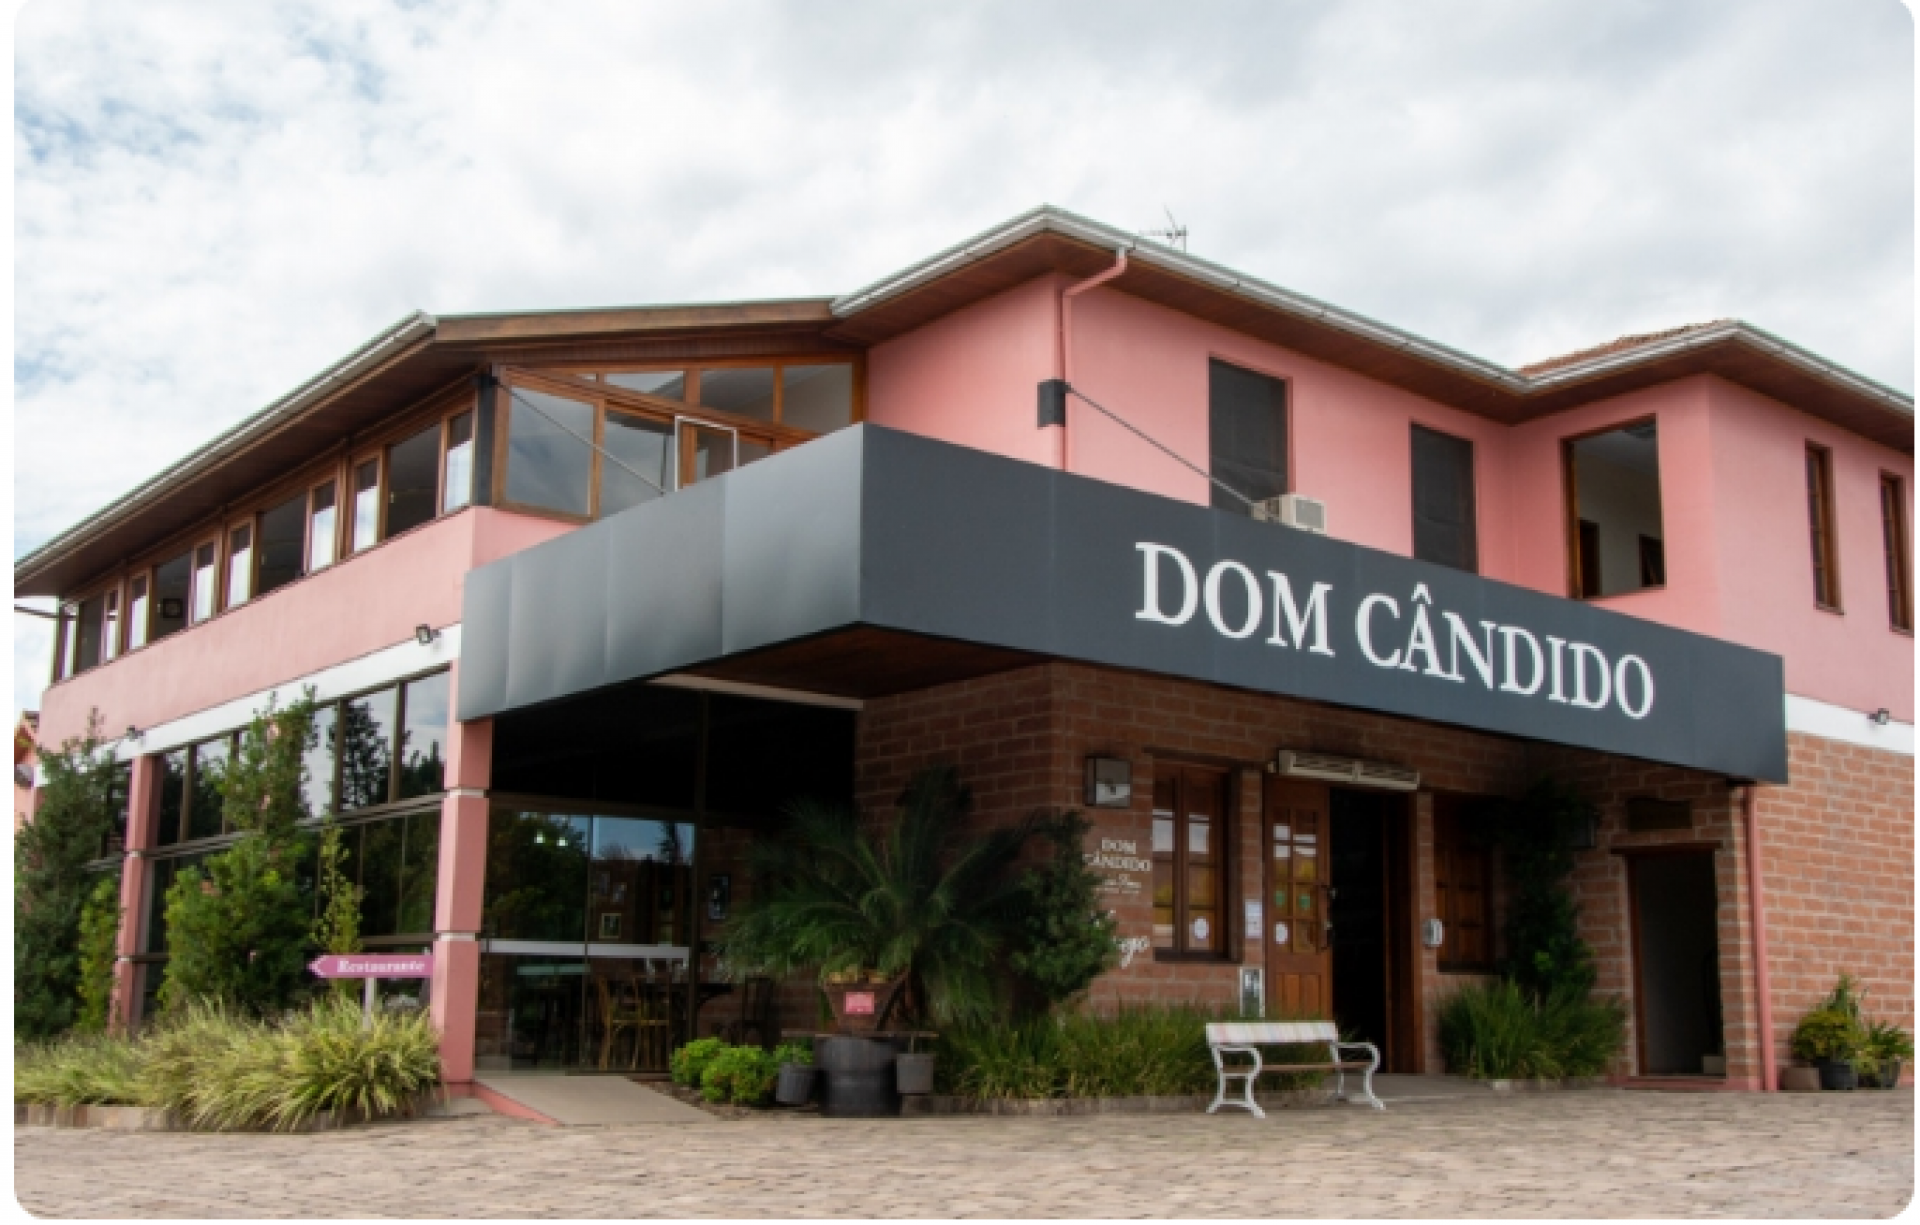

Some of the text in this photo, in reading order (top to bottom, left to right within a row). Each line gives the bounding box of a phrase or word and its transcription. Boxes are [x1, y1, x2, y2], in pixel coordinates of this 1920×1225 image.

[1135, 541, 1654, 720] DOM CÂNDIDO
[1101, 837, 1137, 855] DOM
[337, 958, 426, 973] Restaurante
